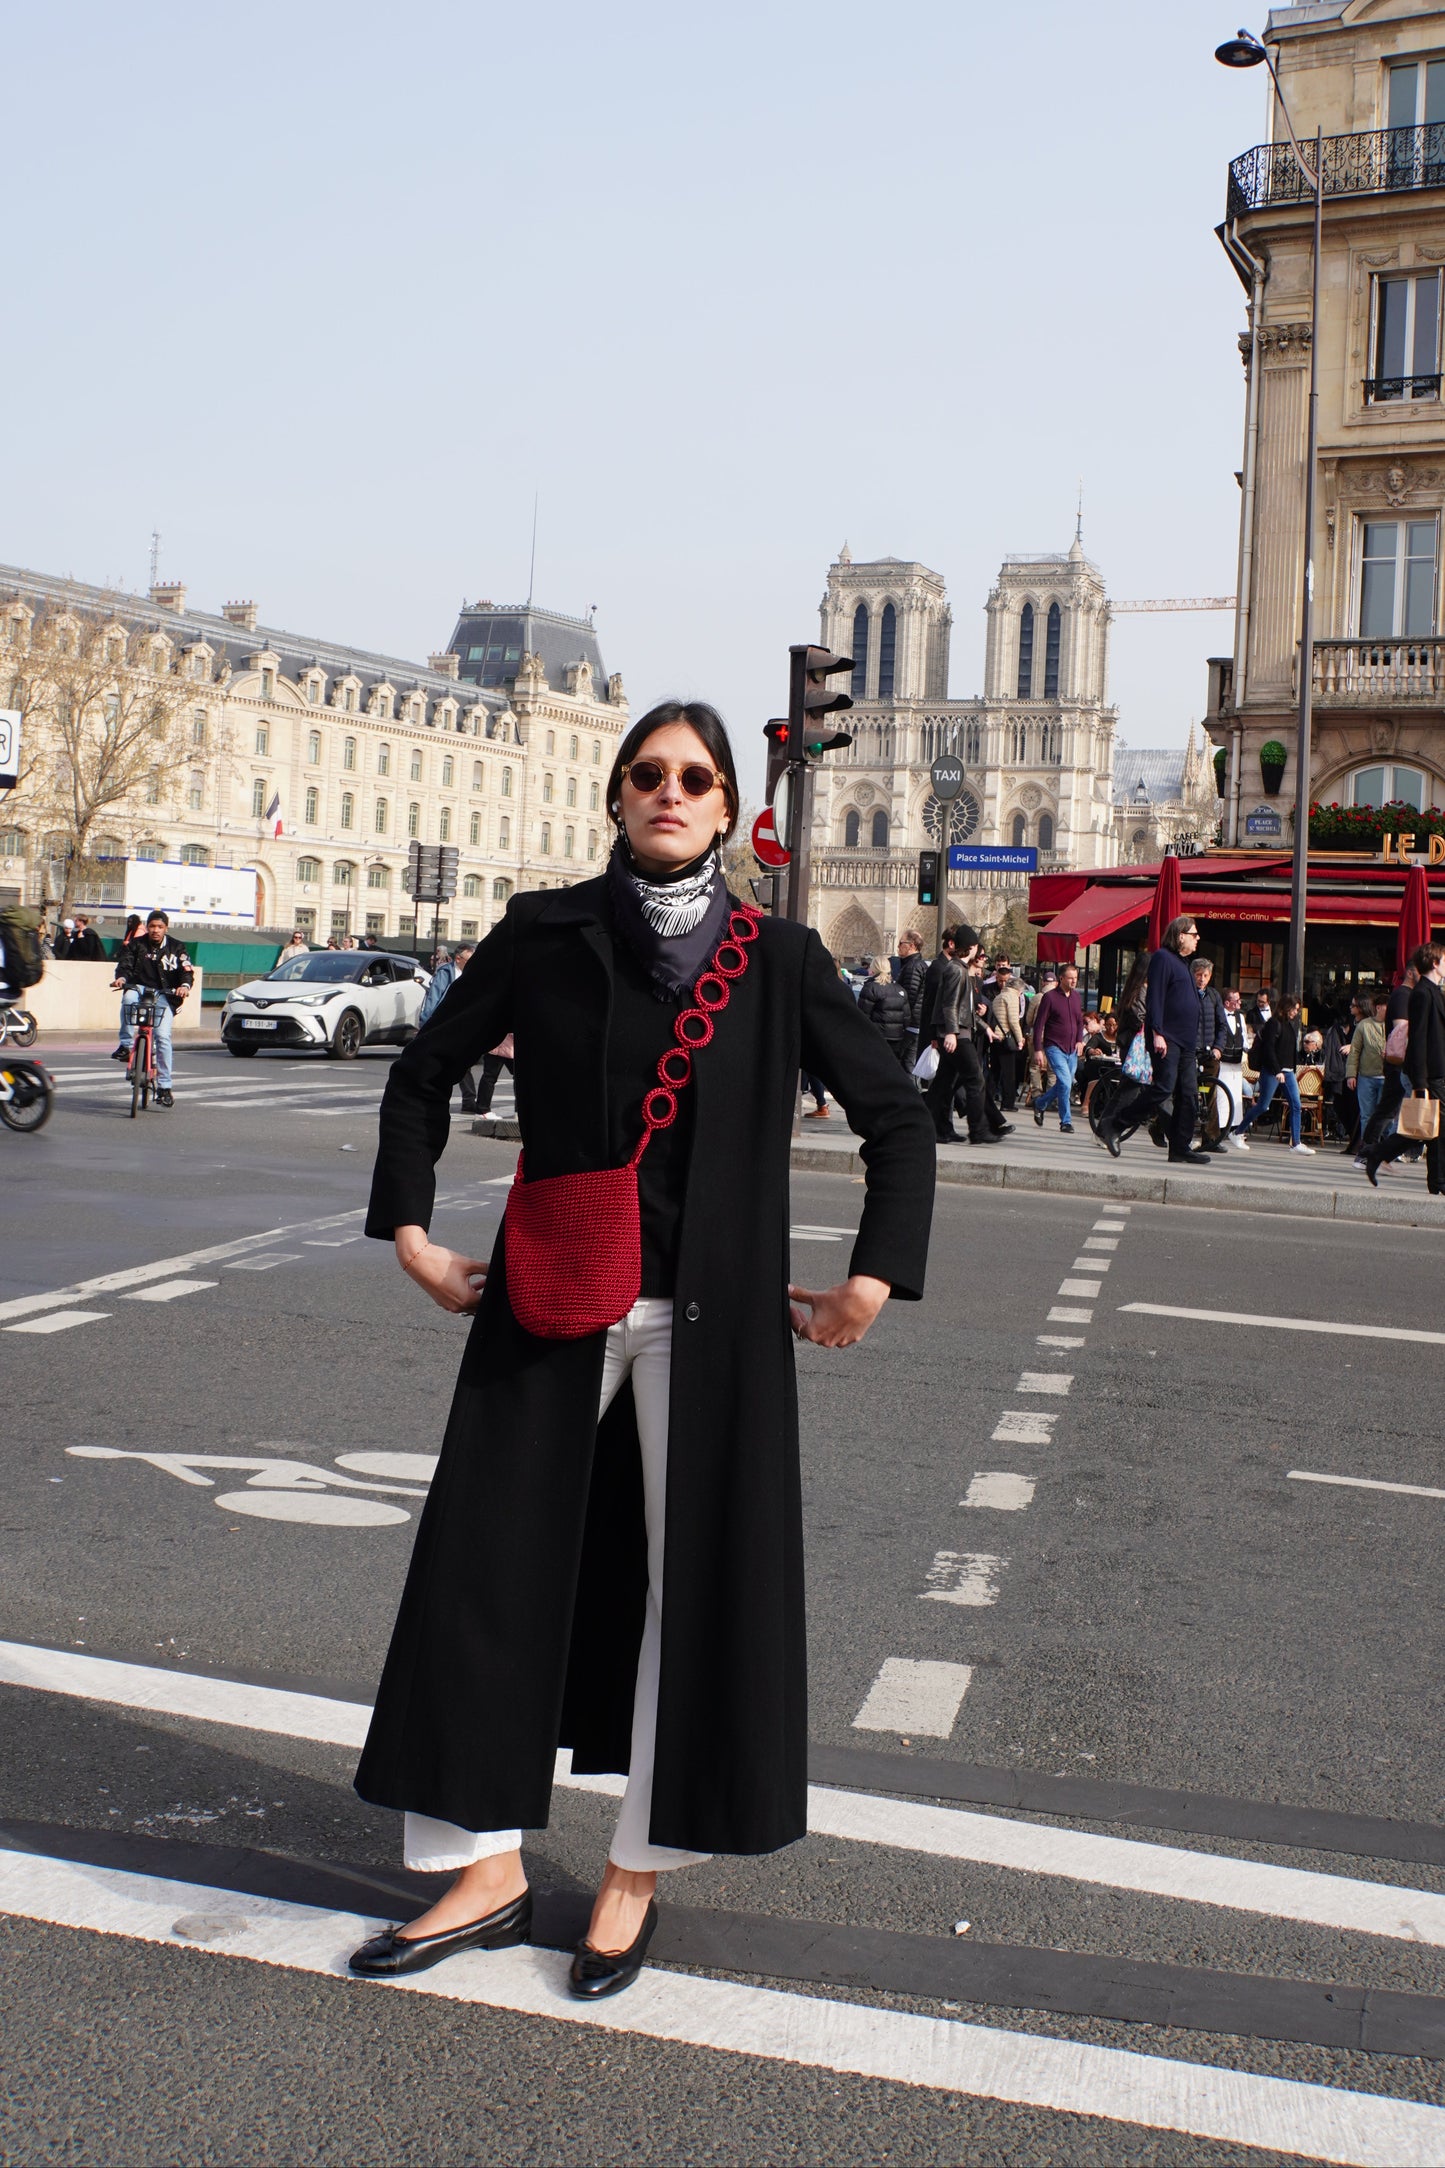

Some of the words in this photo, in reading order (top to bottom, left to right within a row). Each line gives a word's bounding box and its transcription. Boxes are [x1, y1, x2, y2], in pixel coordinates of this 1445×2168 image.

[934, 770, 960, 781] TAXI
[1383, 833, 1415, 864] LE
[956, 853, 978, 862] Place
[980, 854, 1029, 863] Saint-Michel
[1208, 911, 1236, 919] Service
[1240, 912, 1269, 921] Continu
